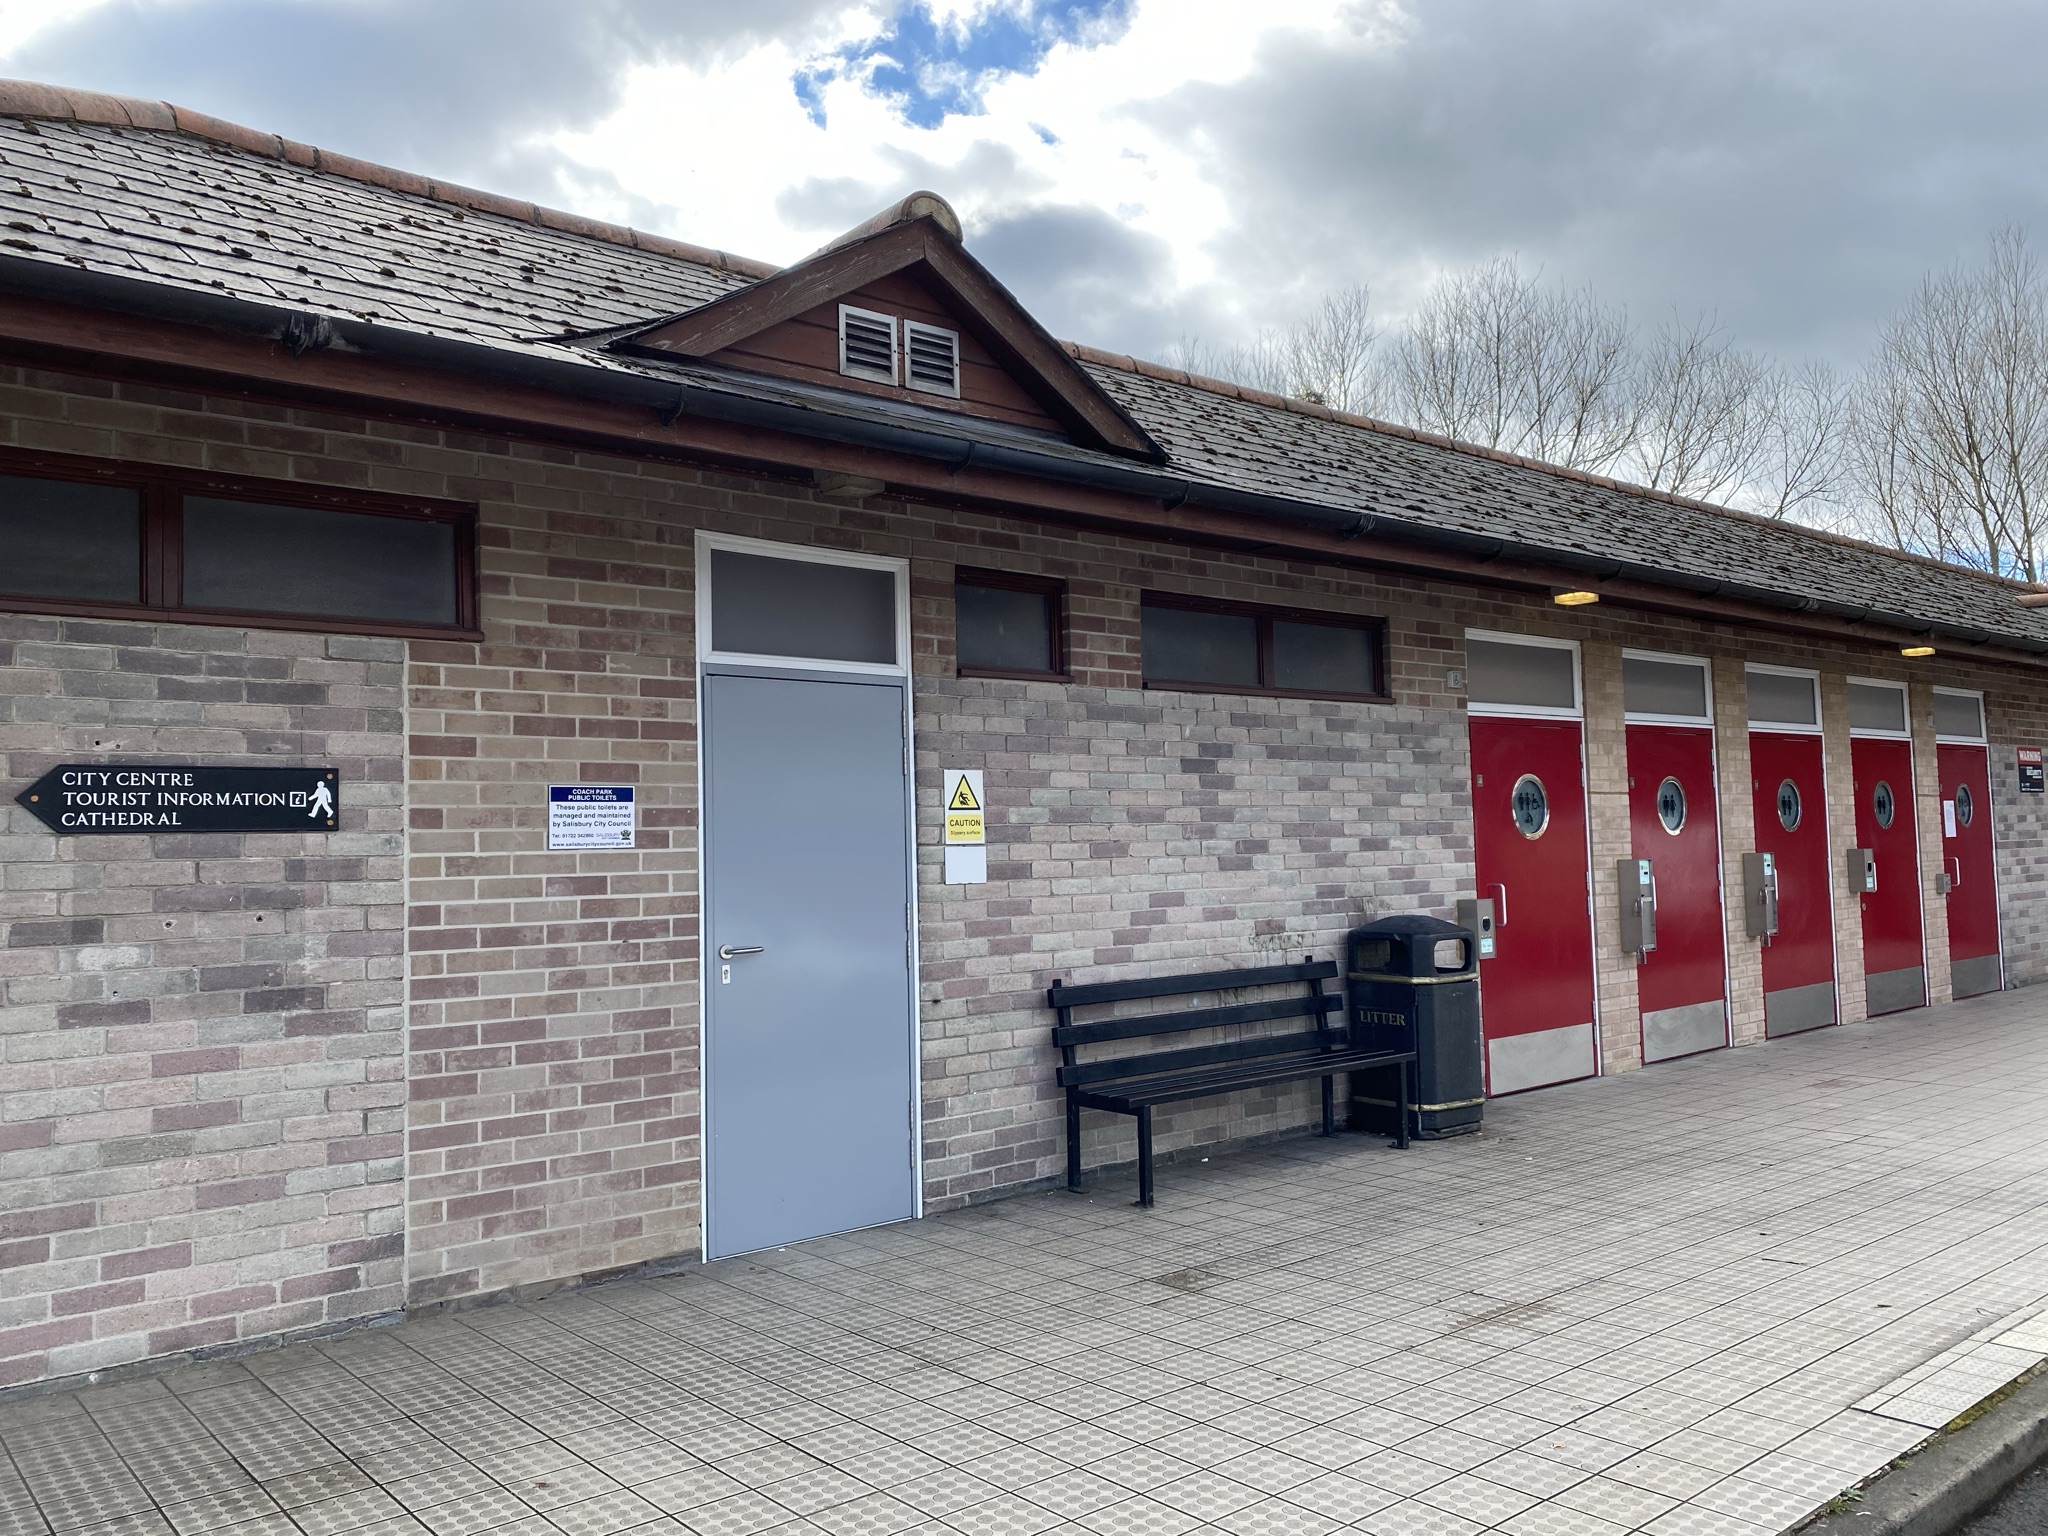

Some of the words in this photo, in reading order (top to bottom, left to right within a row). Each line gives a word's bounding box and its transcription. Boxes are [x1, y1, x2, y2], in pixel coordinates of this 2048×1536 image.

[2018, 750, 2041, 761] WARNING
[61, 772, 112, 787] CITY
[116, 772, 194, 787] CENTRE
[62, 791, 155, 807] TOURIST
[157, 792, 286, 807] INFORMATION
[61, 811, 182, 827] CATHEDRAL
[949, 819, 981, 827] CAUTION
[1360, 1010, 1406, 1027] LITTER
